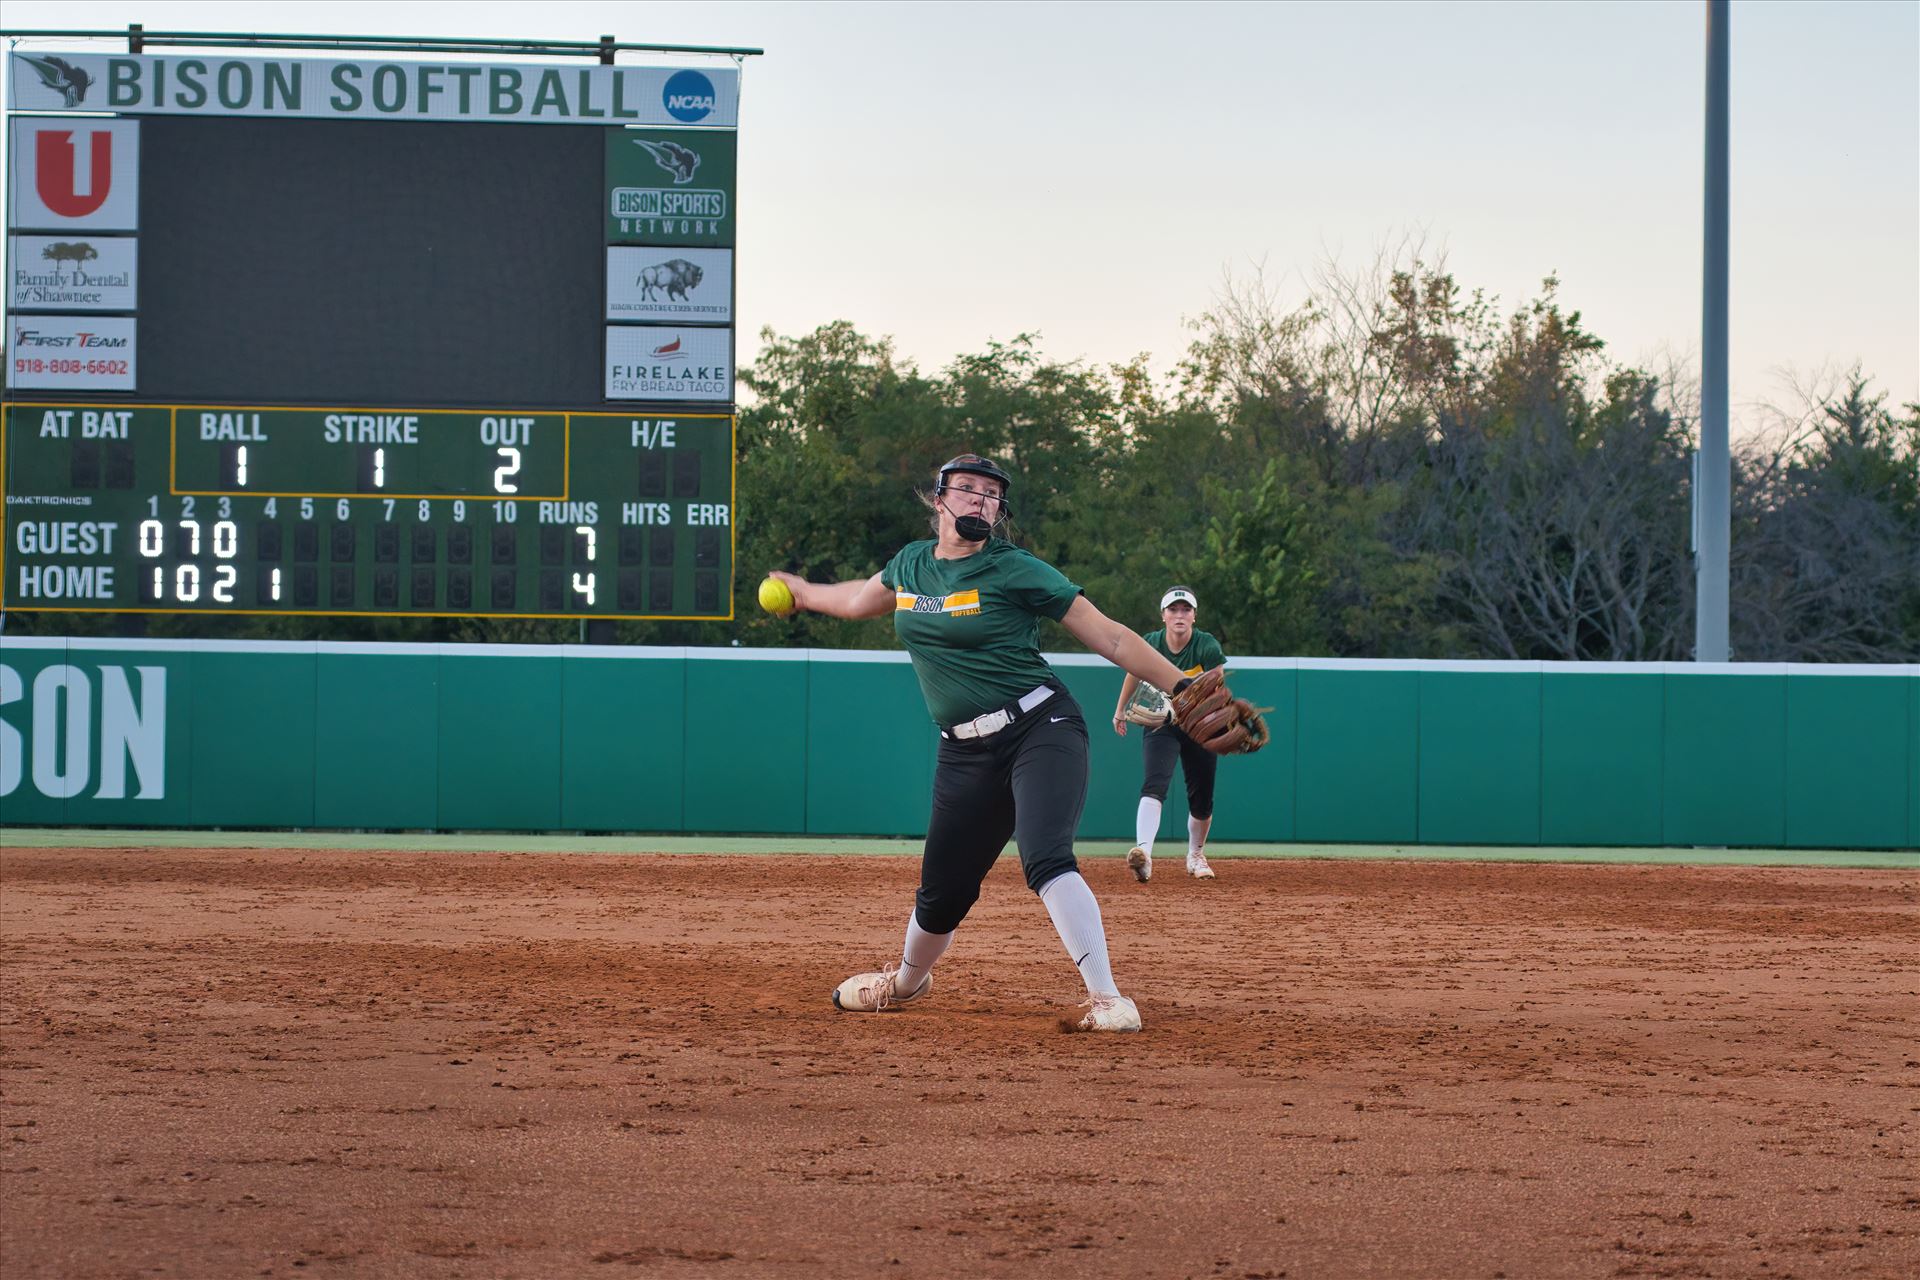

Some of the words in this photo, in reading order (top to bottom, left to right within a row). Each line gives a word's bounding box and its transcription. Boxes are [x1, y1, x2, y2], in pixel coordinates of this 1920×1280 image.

[107, 58, 302, 111] BISON
[330, 63, 639, 118] SOFTBALL
[668, 95, 713, 109] NCAA
[619, 192, 659, 213] BISON
[663, 193, 721, 215] SPORTS
[620, 219, 719, 235] NETWORK
[16, 270, 69, 289] Family
[72, 271, 129, 287] Dental
[16, 288, 33, 304] of
[32, 286, 102, 303] Shawnee
[612, 365, 726, 381] FIRELAKE
[613, 381, 637, 392] FRY
[640, 381, 686, 393] BREAD
[688, 381, 727, 394] TACO
[39, 410, 75, 439] AT
[81, 411, 134, 440] BAT
[200, 413, 268, 441] BALL
[324, 415, 419, 444] STRIKE
[480, 417, 535, 446] OUT
[631, 420, 677, 450] H/E
[238, 445, 247, 486] 1
[374, 448, 384, 487] 1
[494, 448, 521, 493] 2
[6, 495, 93, 506] DAKTRONICS
[147, 495, 159, 518] 1
[181, 496, 196, 519] 2
[218, 497, 232, 519] 3
[264, 497, 278, 519] 4
[300, 498, 315, 520] 5
[336, 498, 351, 521] 6
[382, 499, 396, 522] 7
[418, 499, 431, 522] 8
[453, 500, 466, 523] 9
[492, 501, 517, 524] 10
[539, 502, 599, 525] RUNS
[622, 503, 671, 526] HITS
[687, 504, 730, 527] ERR
[16, 521, 118, 555] GUEST
[139, 520, 163, 557] 0
[179, 520, 200, 555] 7
[213, 520, 237, 558] 0
[575, 526, 596, 561] 7
[19, 565, 115, 599] HOME
[154, 566, 163, 599] 1
[176, 564, 200, 602] 0
[212, 564, 237, 602] 2
[272, 568, 281, 600] 1
[572, 572, 596, 606] 4
[911, 595, 946, 612] BISON
